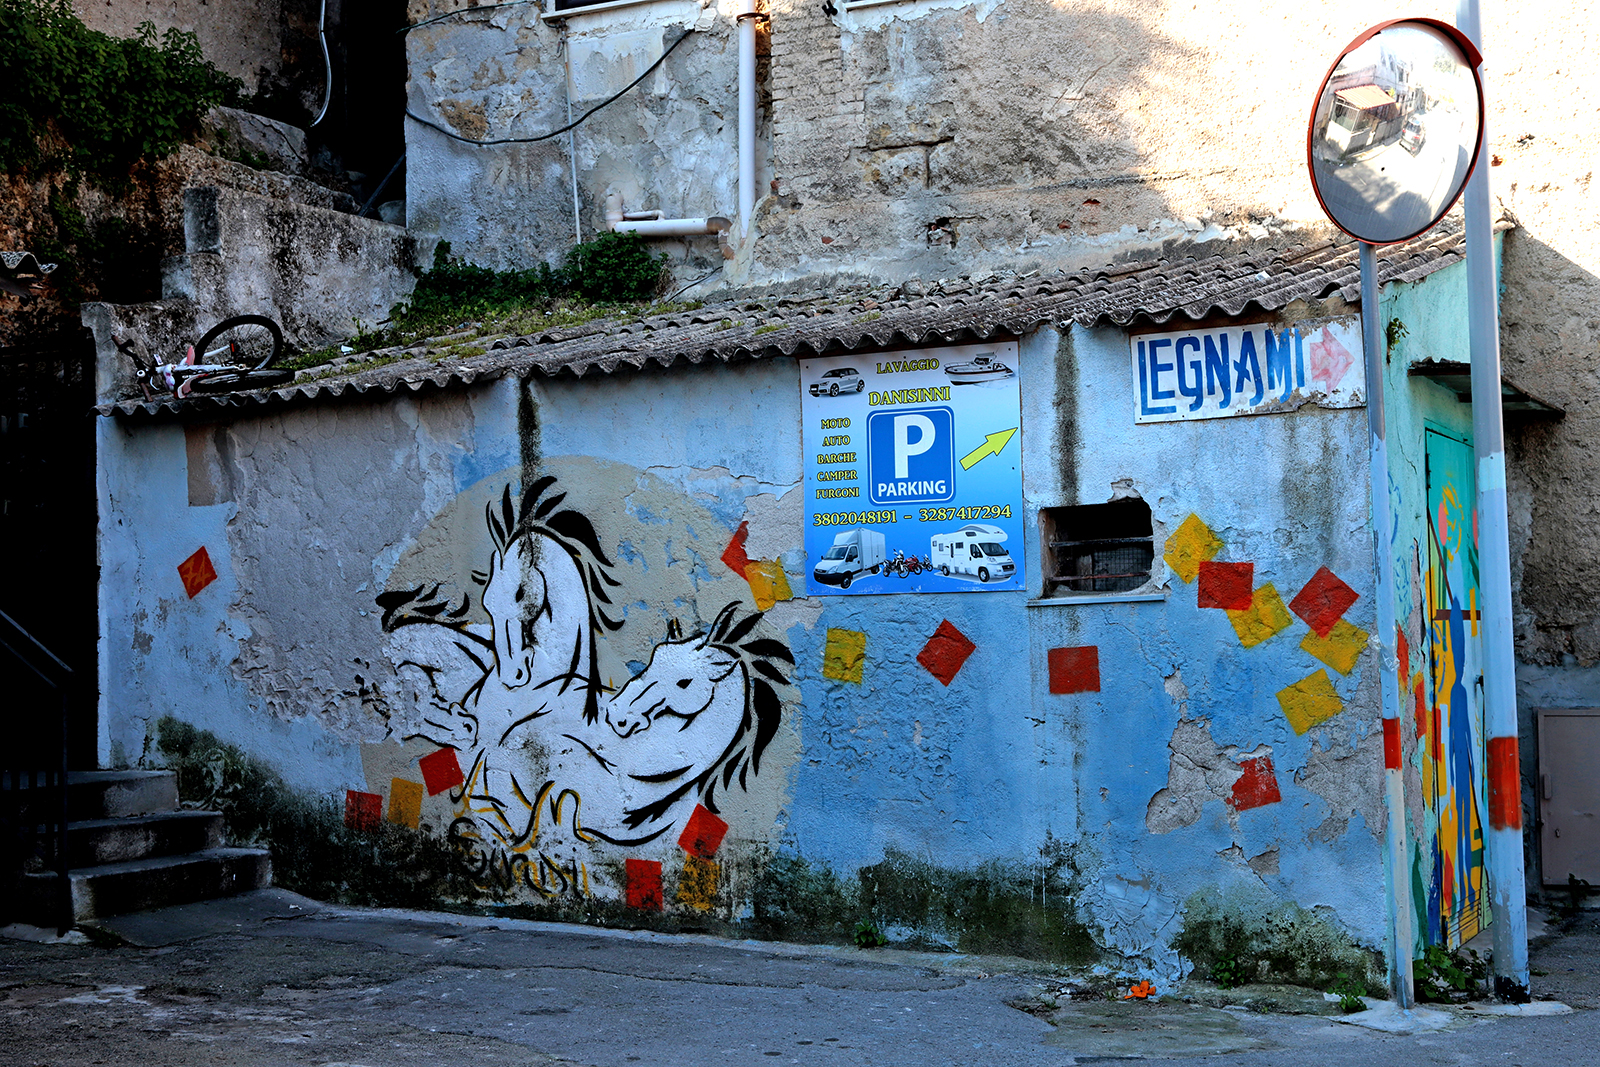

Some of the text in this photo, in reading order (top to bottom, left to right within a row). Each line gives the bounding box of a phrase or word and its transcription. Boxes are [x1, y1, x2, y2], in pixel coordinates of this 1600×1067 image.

[876, 358, 940, 374] LAVAGGIO
[1137, 327, 1305, 416] LEGNAMI
[868, 386, 951, 406] DANISINNI
[821, 418, 851, 429] MOTO
[822, 435, 850, 446] AUTO
[893, 414, 936, 479] P
[817, 452, 857, 464] BARCHE
[817, 470, 858, 481] CAMPER
[816, 487, 860, 499] FURGONI
[877, 480, 946, 497] PARKING
[813, 510, 897, 526] 3802048191
[919, 505, 1012, 522] 3287417294
